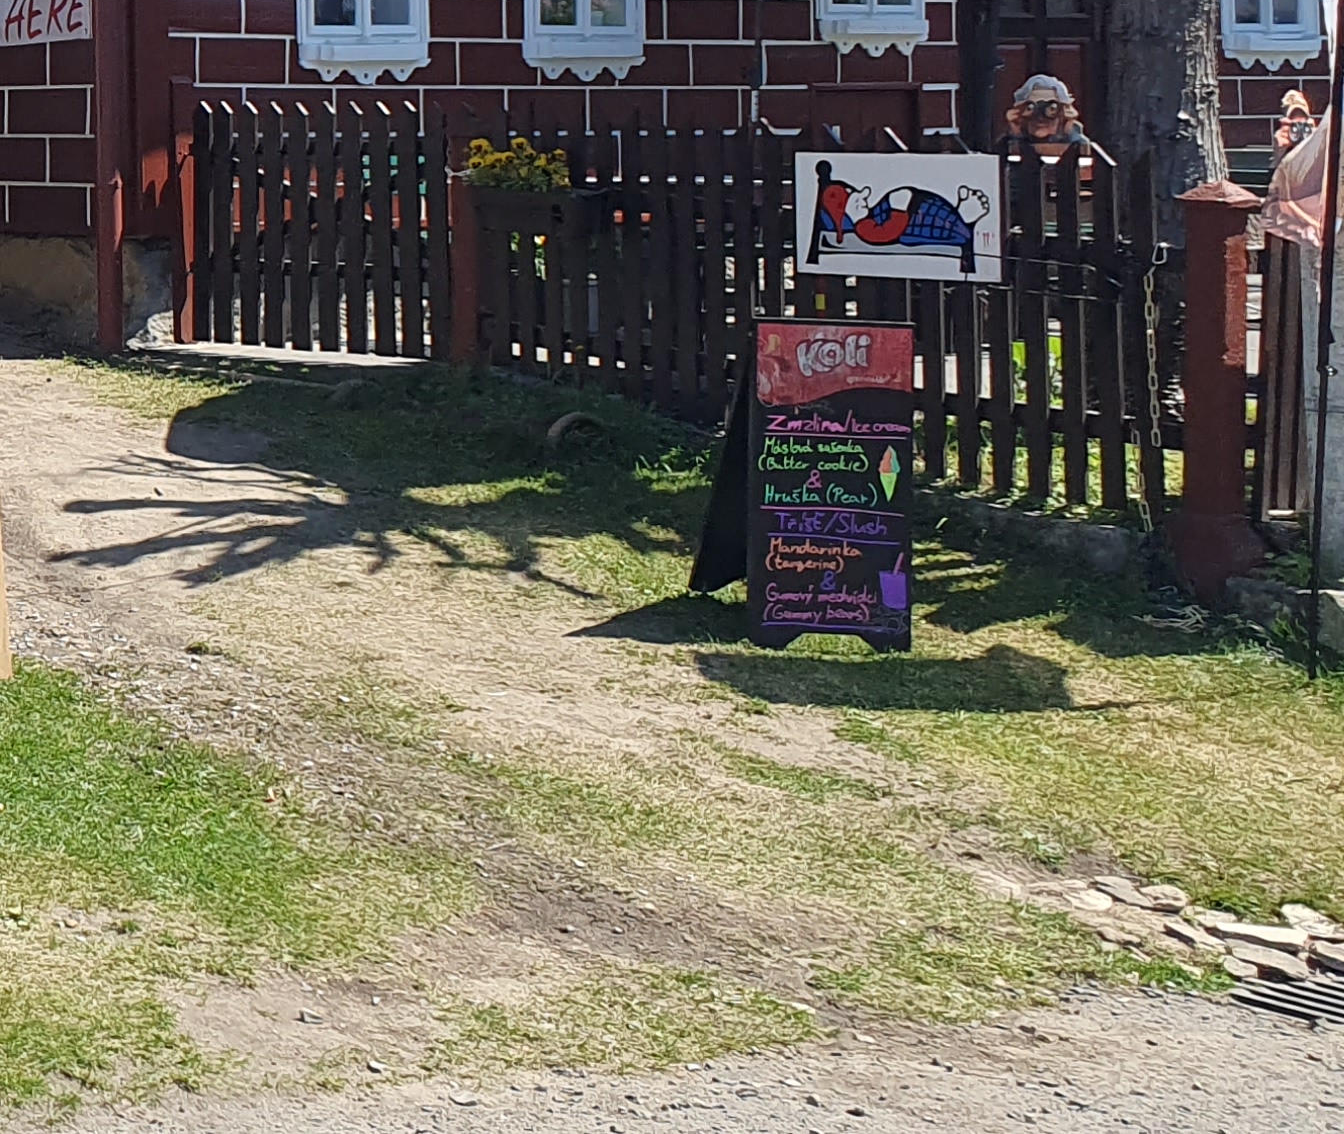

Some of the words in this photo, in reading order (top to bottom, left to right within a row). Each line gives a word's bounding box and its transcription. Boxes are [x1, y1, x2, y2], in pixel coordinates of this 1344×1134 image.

[796, 335, 871, 377] Koli
[807, 470, 823, 488] &
[764, 483, 821, 504] Hruška
[826, 482, 878, 507] (Pear)
[769, 537, 862, 556] Mandarinka
